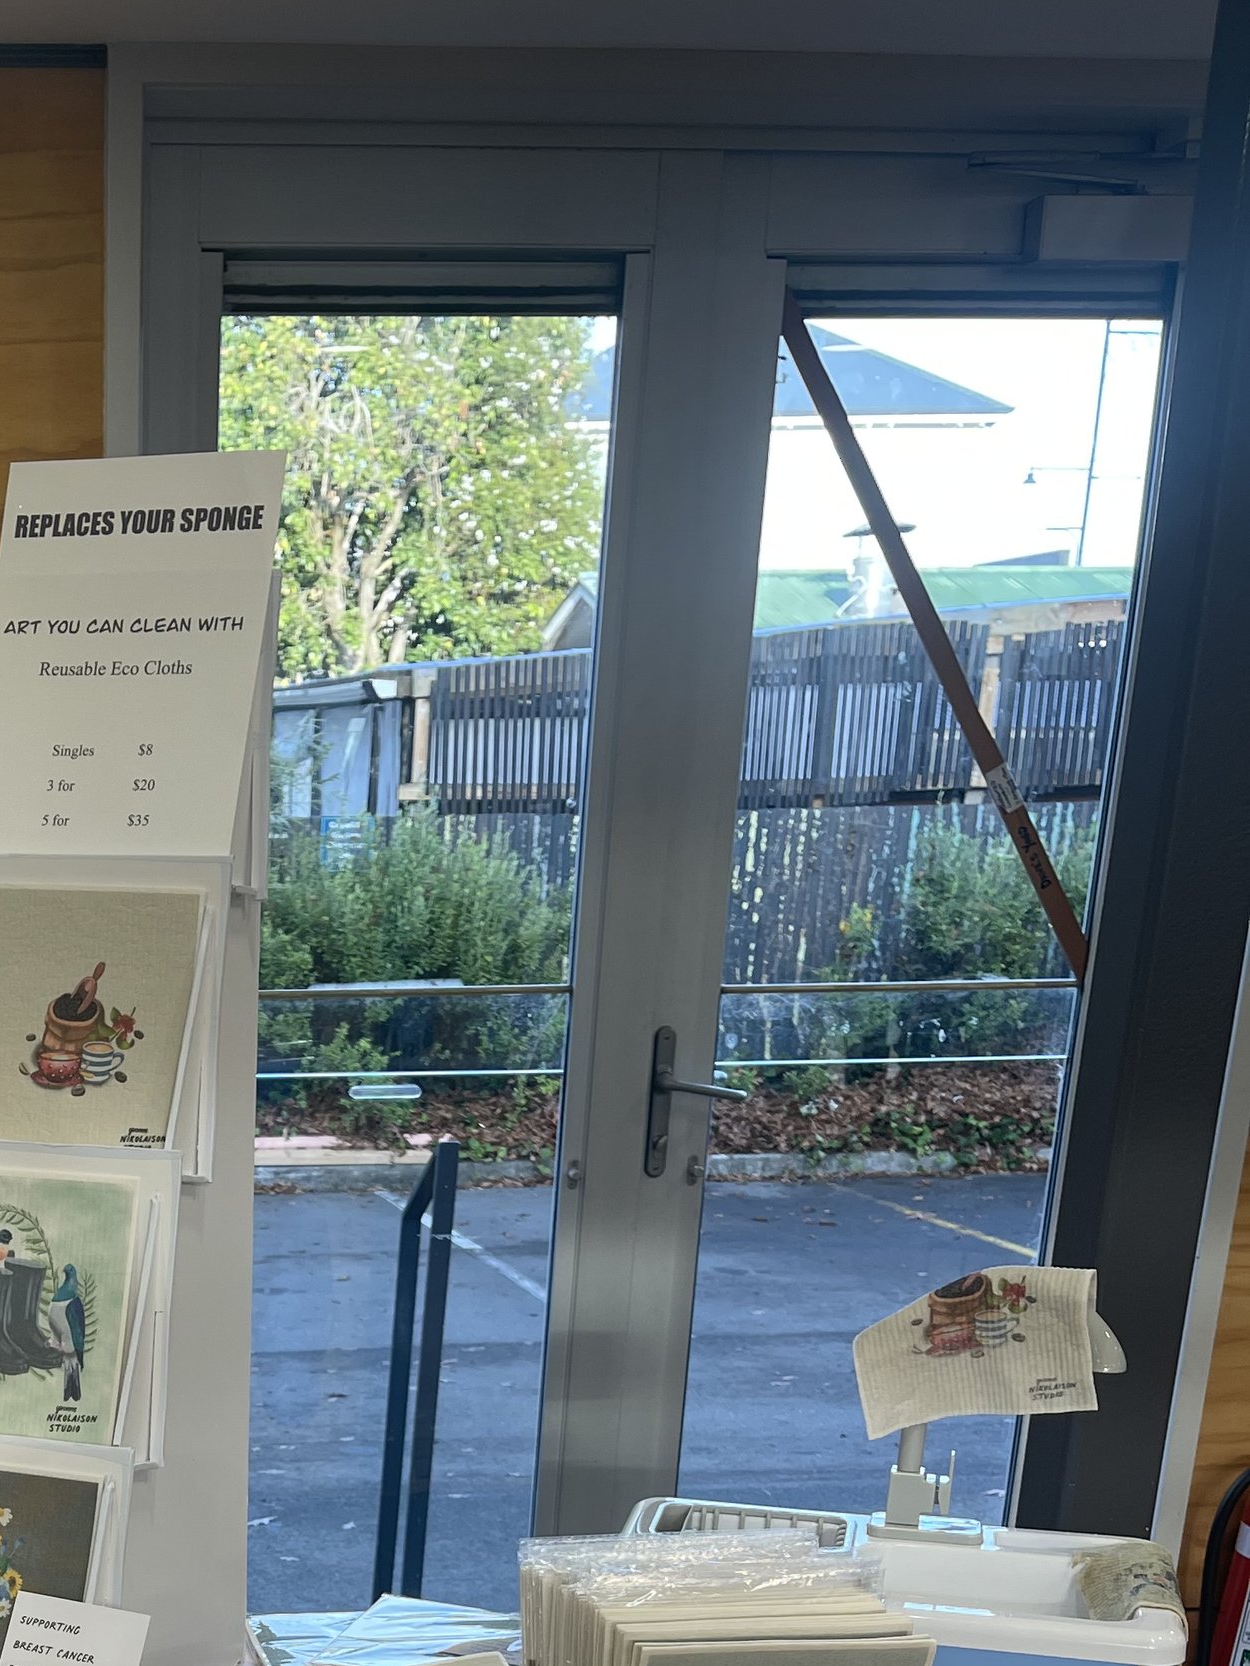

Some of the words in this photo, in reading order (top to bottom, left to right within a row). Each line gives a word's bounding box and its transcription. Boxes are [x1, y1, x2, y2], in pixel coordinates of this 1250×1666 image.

[14, 511, 115, 538] REPLACES
[119, 508, 175, 535] YOUR
[180, 504, 265, 532] SPONGE
[4, 619, 42, 634] ART
[47, 619, 81, 634] YOU
[86, 618, 124, 633] CAN
[129, 617, 192, 633] CLEAN
[198, 616, 244, 632] WITH
[39, 660, 107, 677] Reusable
[110, 661, 139, 676] Eco
[144, 659, 193, 675] Cloths
[52, 744, 94, 760] Singles
[138, 743, 153, 757] $8
[46, 780, 54, 792] 3
[57, 779, 75, 793] for
[132, 778, 155, 792] $20
[41, 814, 49, 827] 5
[52, 814, 70, 827] for
[127, 814, 149, 827] $35
[46, 1413, 98, 1423] NIKOLAISON
[49, 1424, 81, 1433] STUDIO
[20, 1615, 81, 1635] SUPPORTING
[13, 1640, 53, 1655] BREAST
[56, 1649, 94, 1664] CANCER
